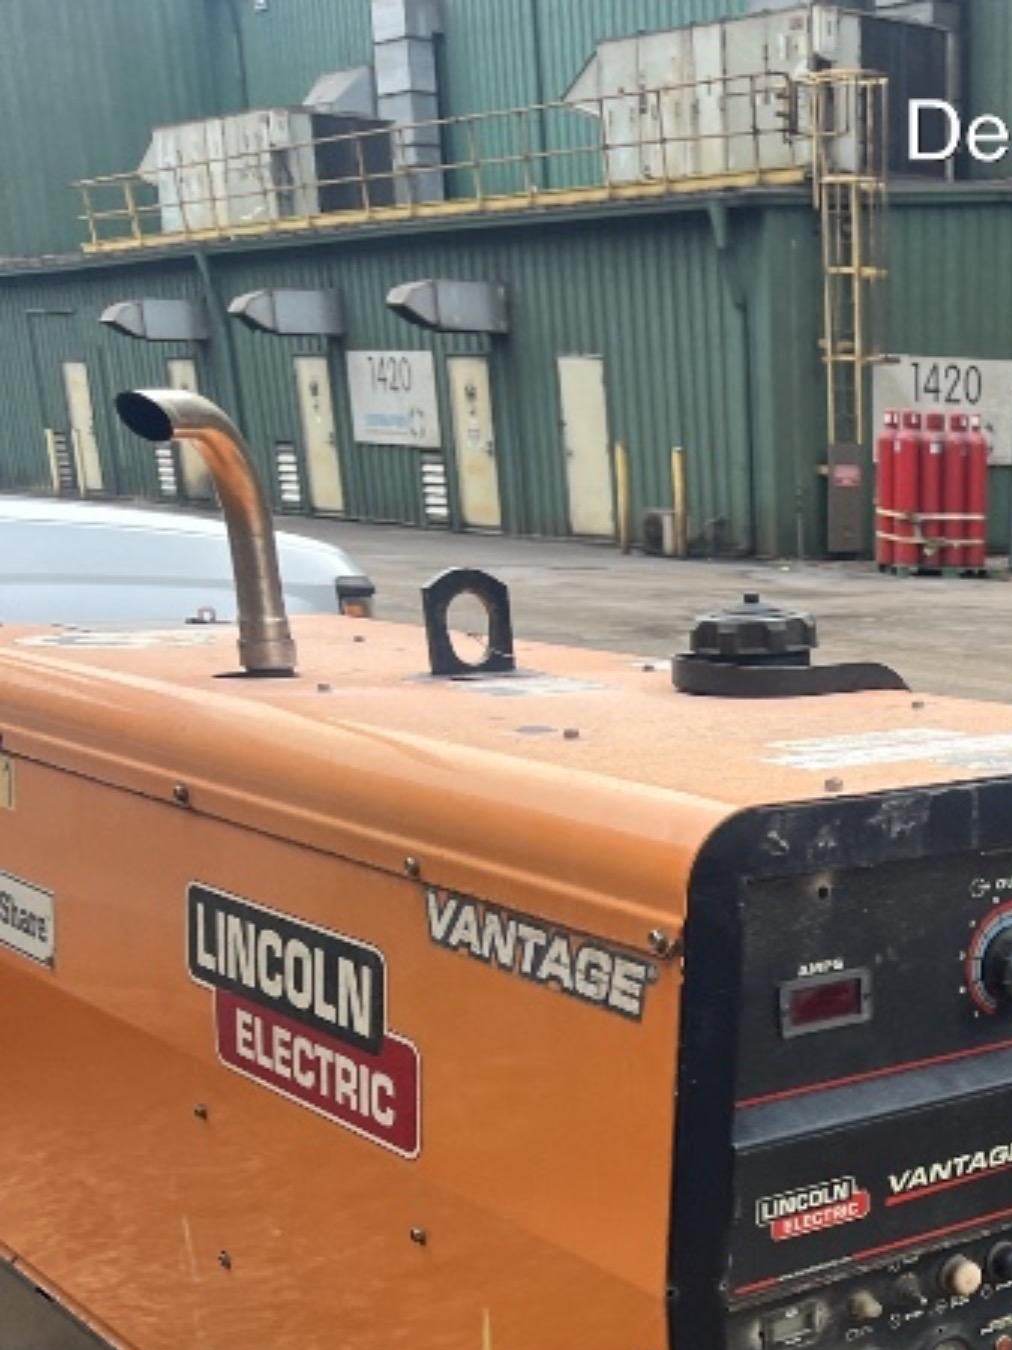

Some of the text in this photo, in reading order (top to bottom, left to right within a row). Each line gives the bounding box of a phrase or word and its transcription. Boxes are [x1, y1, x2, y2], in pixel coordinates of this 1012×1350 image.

[367, 356, 412, 392] 1420
[911, 362, 982, 406] 1420
[196, 902, 372, 1038] LINCOLN
[425, 889, 648, 1015] VANTAGE
[236, 1009, 396, 1129] ELECTRIC
[761, 1181, 849, 1218] LINCOLN
[783, 1201, 859, 1233] ELECTRIC
